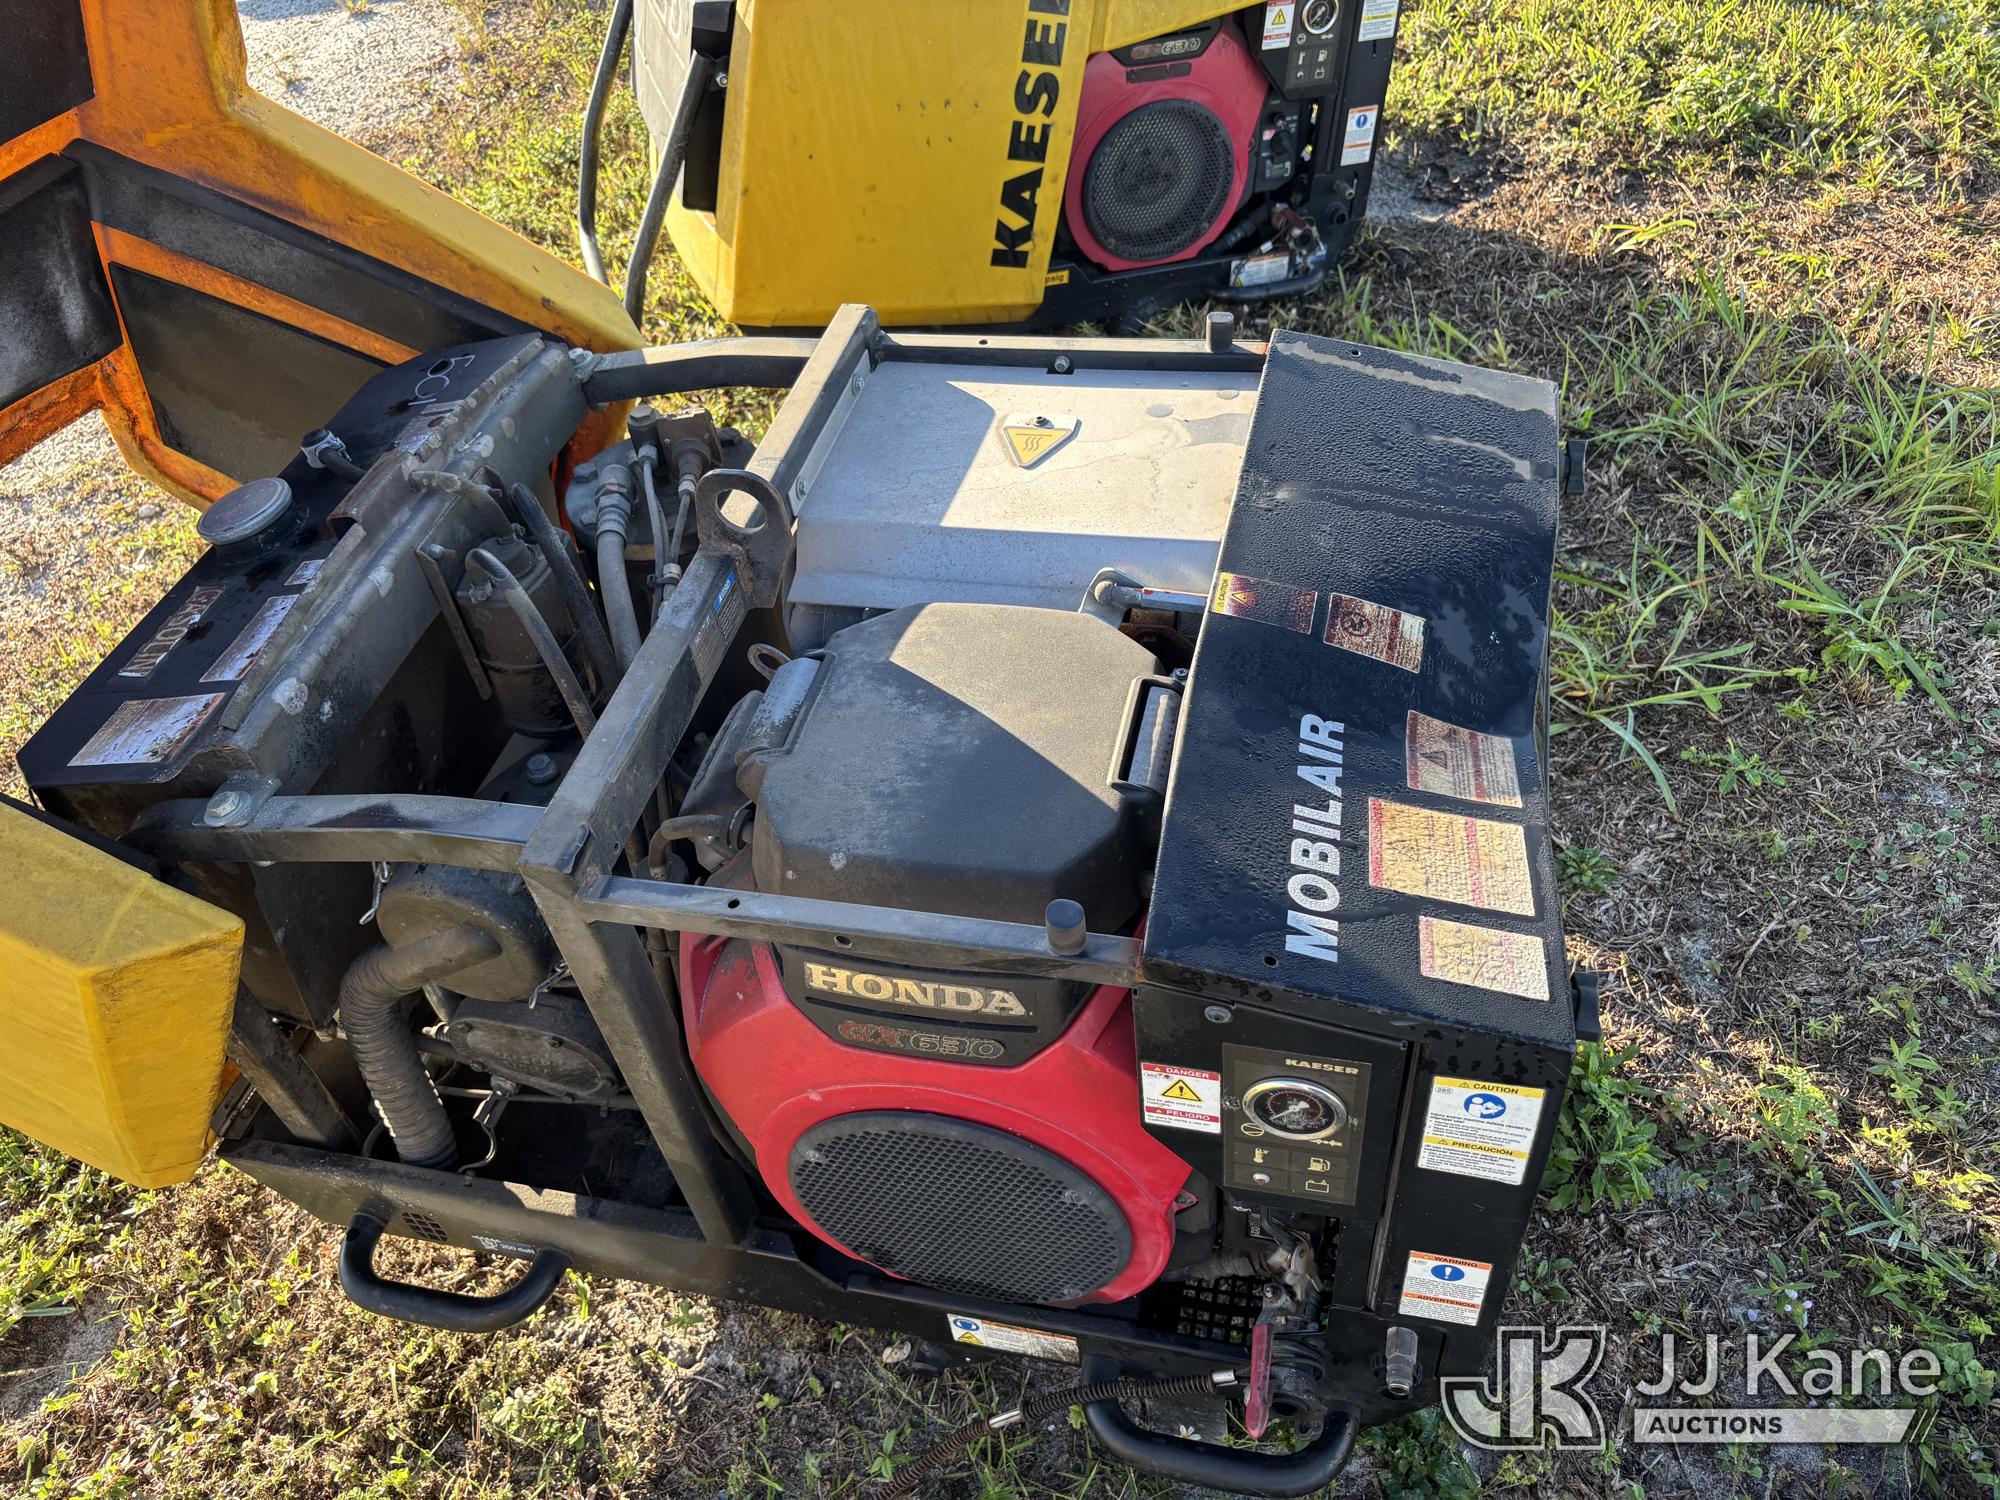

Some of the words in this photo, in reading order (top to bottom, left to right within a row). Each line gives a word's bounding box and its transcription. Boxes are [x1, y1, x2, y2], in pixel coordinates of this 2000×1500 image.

[1285, 713, 1345, 962] MOBILAIR
[805, 962, 1027, 1016] HONDA
[1166, 1067, 1209, 1079] DANGER
[1285, 1058, 1359, 1075] KAESER
[1473, 1083, 1519, 1095] CAUTION
[1166, 1109, 1210, 1121] PELIGRO
[1452, 1141, 1513, 1156] PRECAUCIÓN
[1434, 1256, 1478, 1268] WARNING
[1417, 1294, 1476, 1308] ADVERTENCIA
